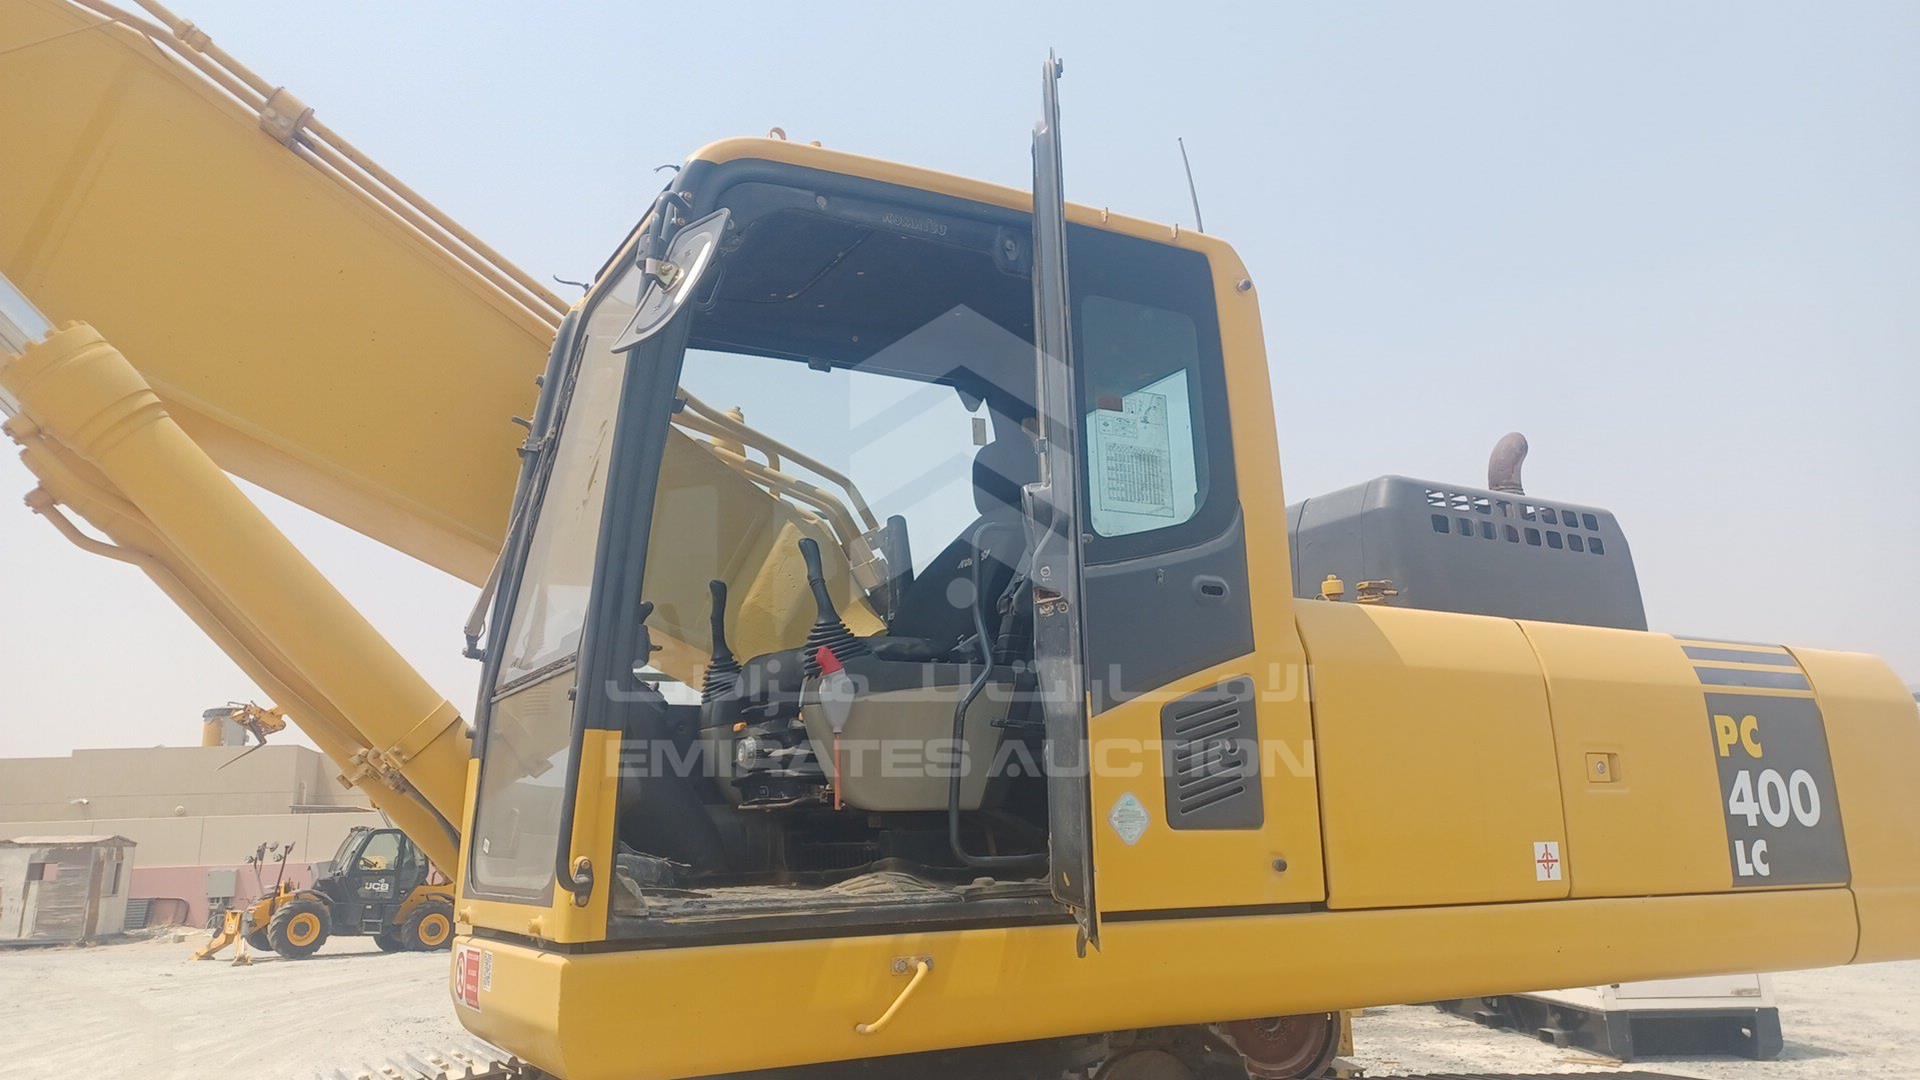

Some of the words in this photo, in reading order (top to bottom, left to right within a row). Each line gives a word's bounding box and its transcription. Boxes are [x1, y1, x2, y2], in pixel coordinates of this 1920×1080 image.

[1714, 715, 1763, 758] PC
[1729, 768, 1821, 827] 400
[1735, 839, 1770, 876] LC
[364, 882, 389, 890] JCB
